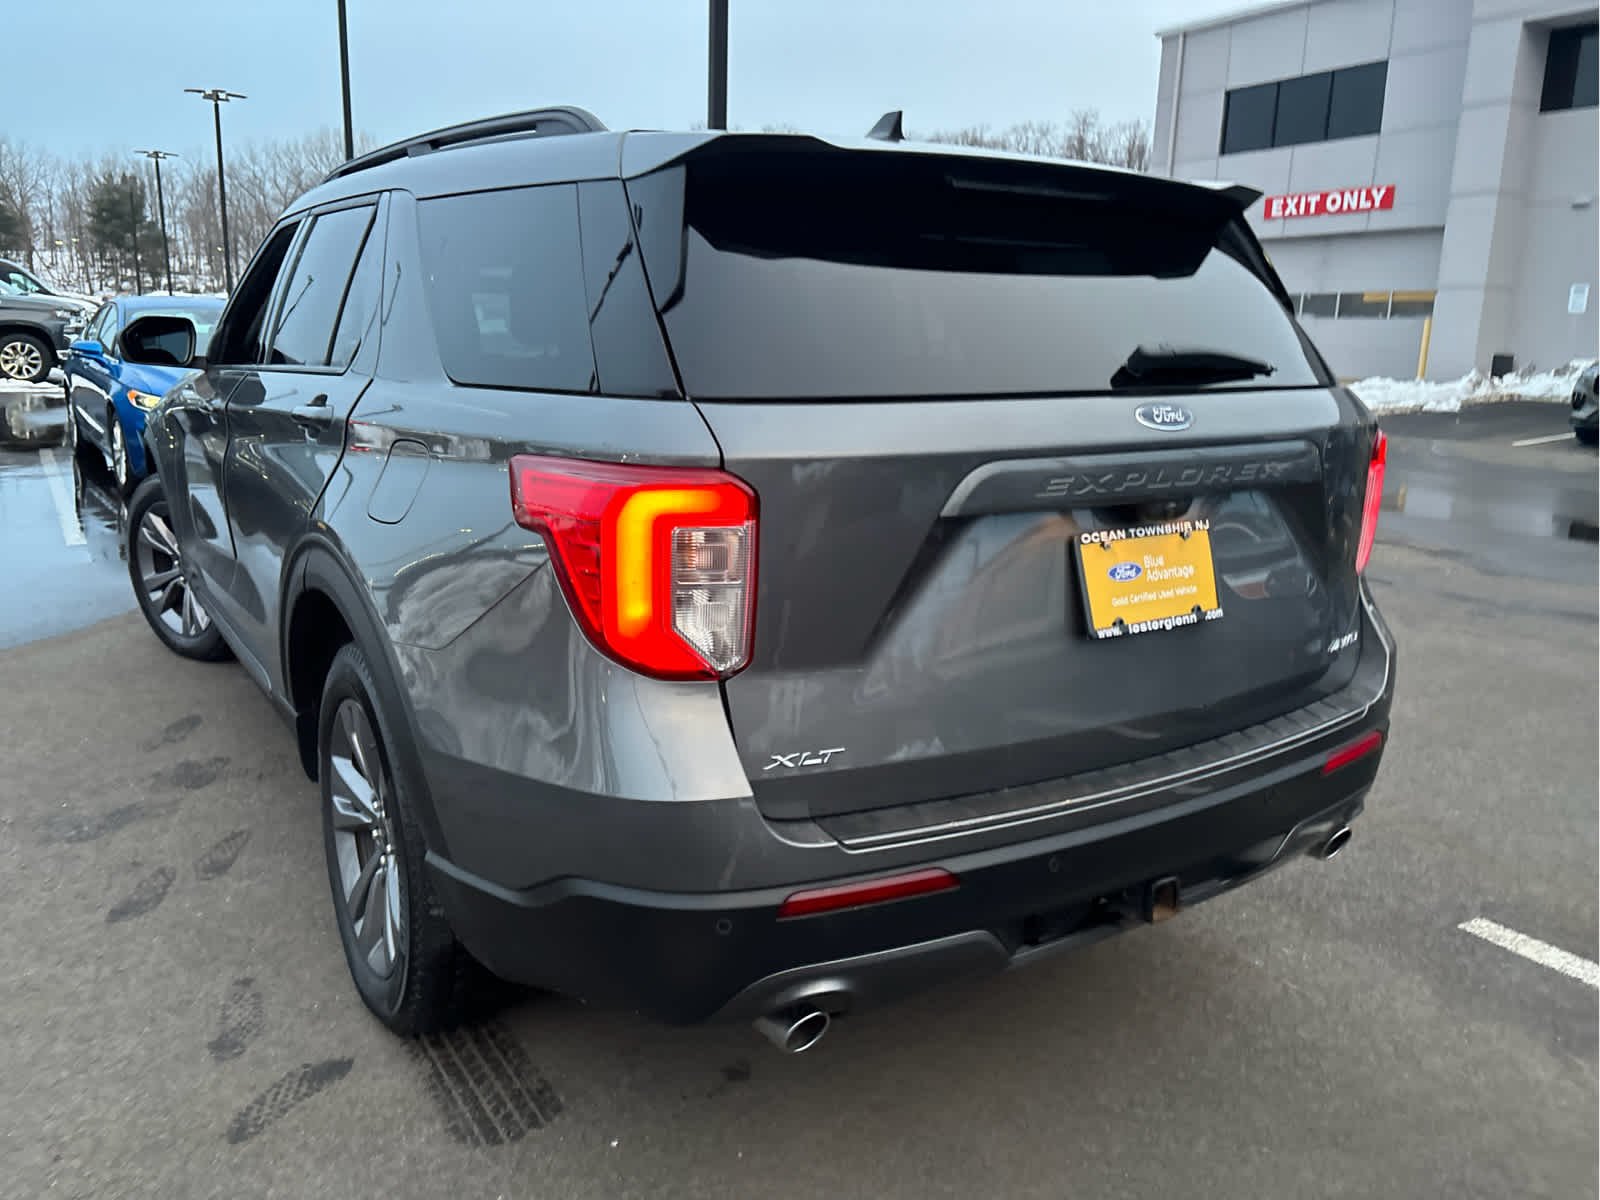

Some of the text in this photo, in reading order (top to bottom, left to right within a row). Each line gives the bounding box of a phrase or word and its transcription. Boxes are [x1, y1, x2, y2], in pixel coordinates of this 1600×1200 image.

[1271, 185, 1387, 217] EXIT ONLY
[1152, 405, 1185, 423] Ford
[1035, 462, 1290, 497] EXPLORER
[1080, 519, 1210, 544] OCEAN TOWNSHIP NJ
[1143, 554, 1164, 568] Blue
[1114, 564, 1137, 579] Ford
[1146, 564, 1194, 582] Advantage
[762, 747, 846, 770] XLT
